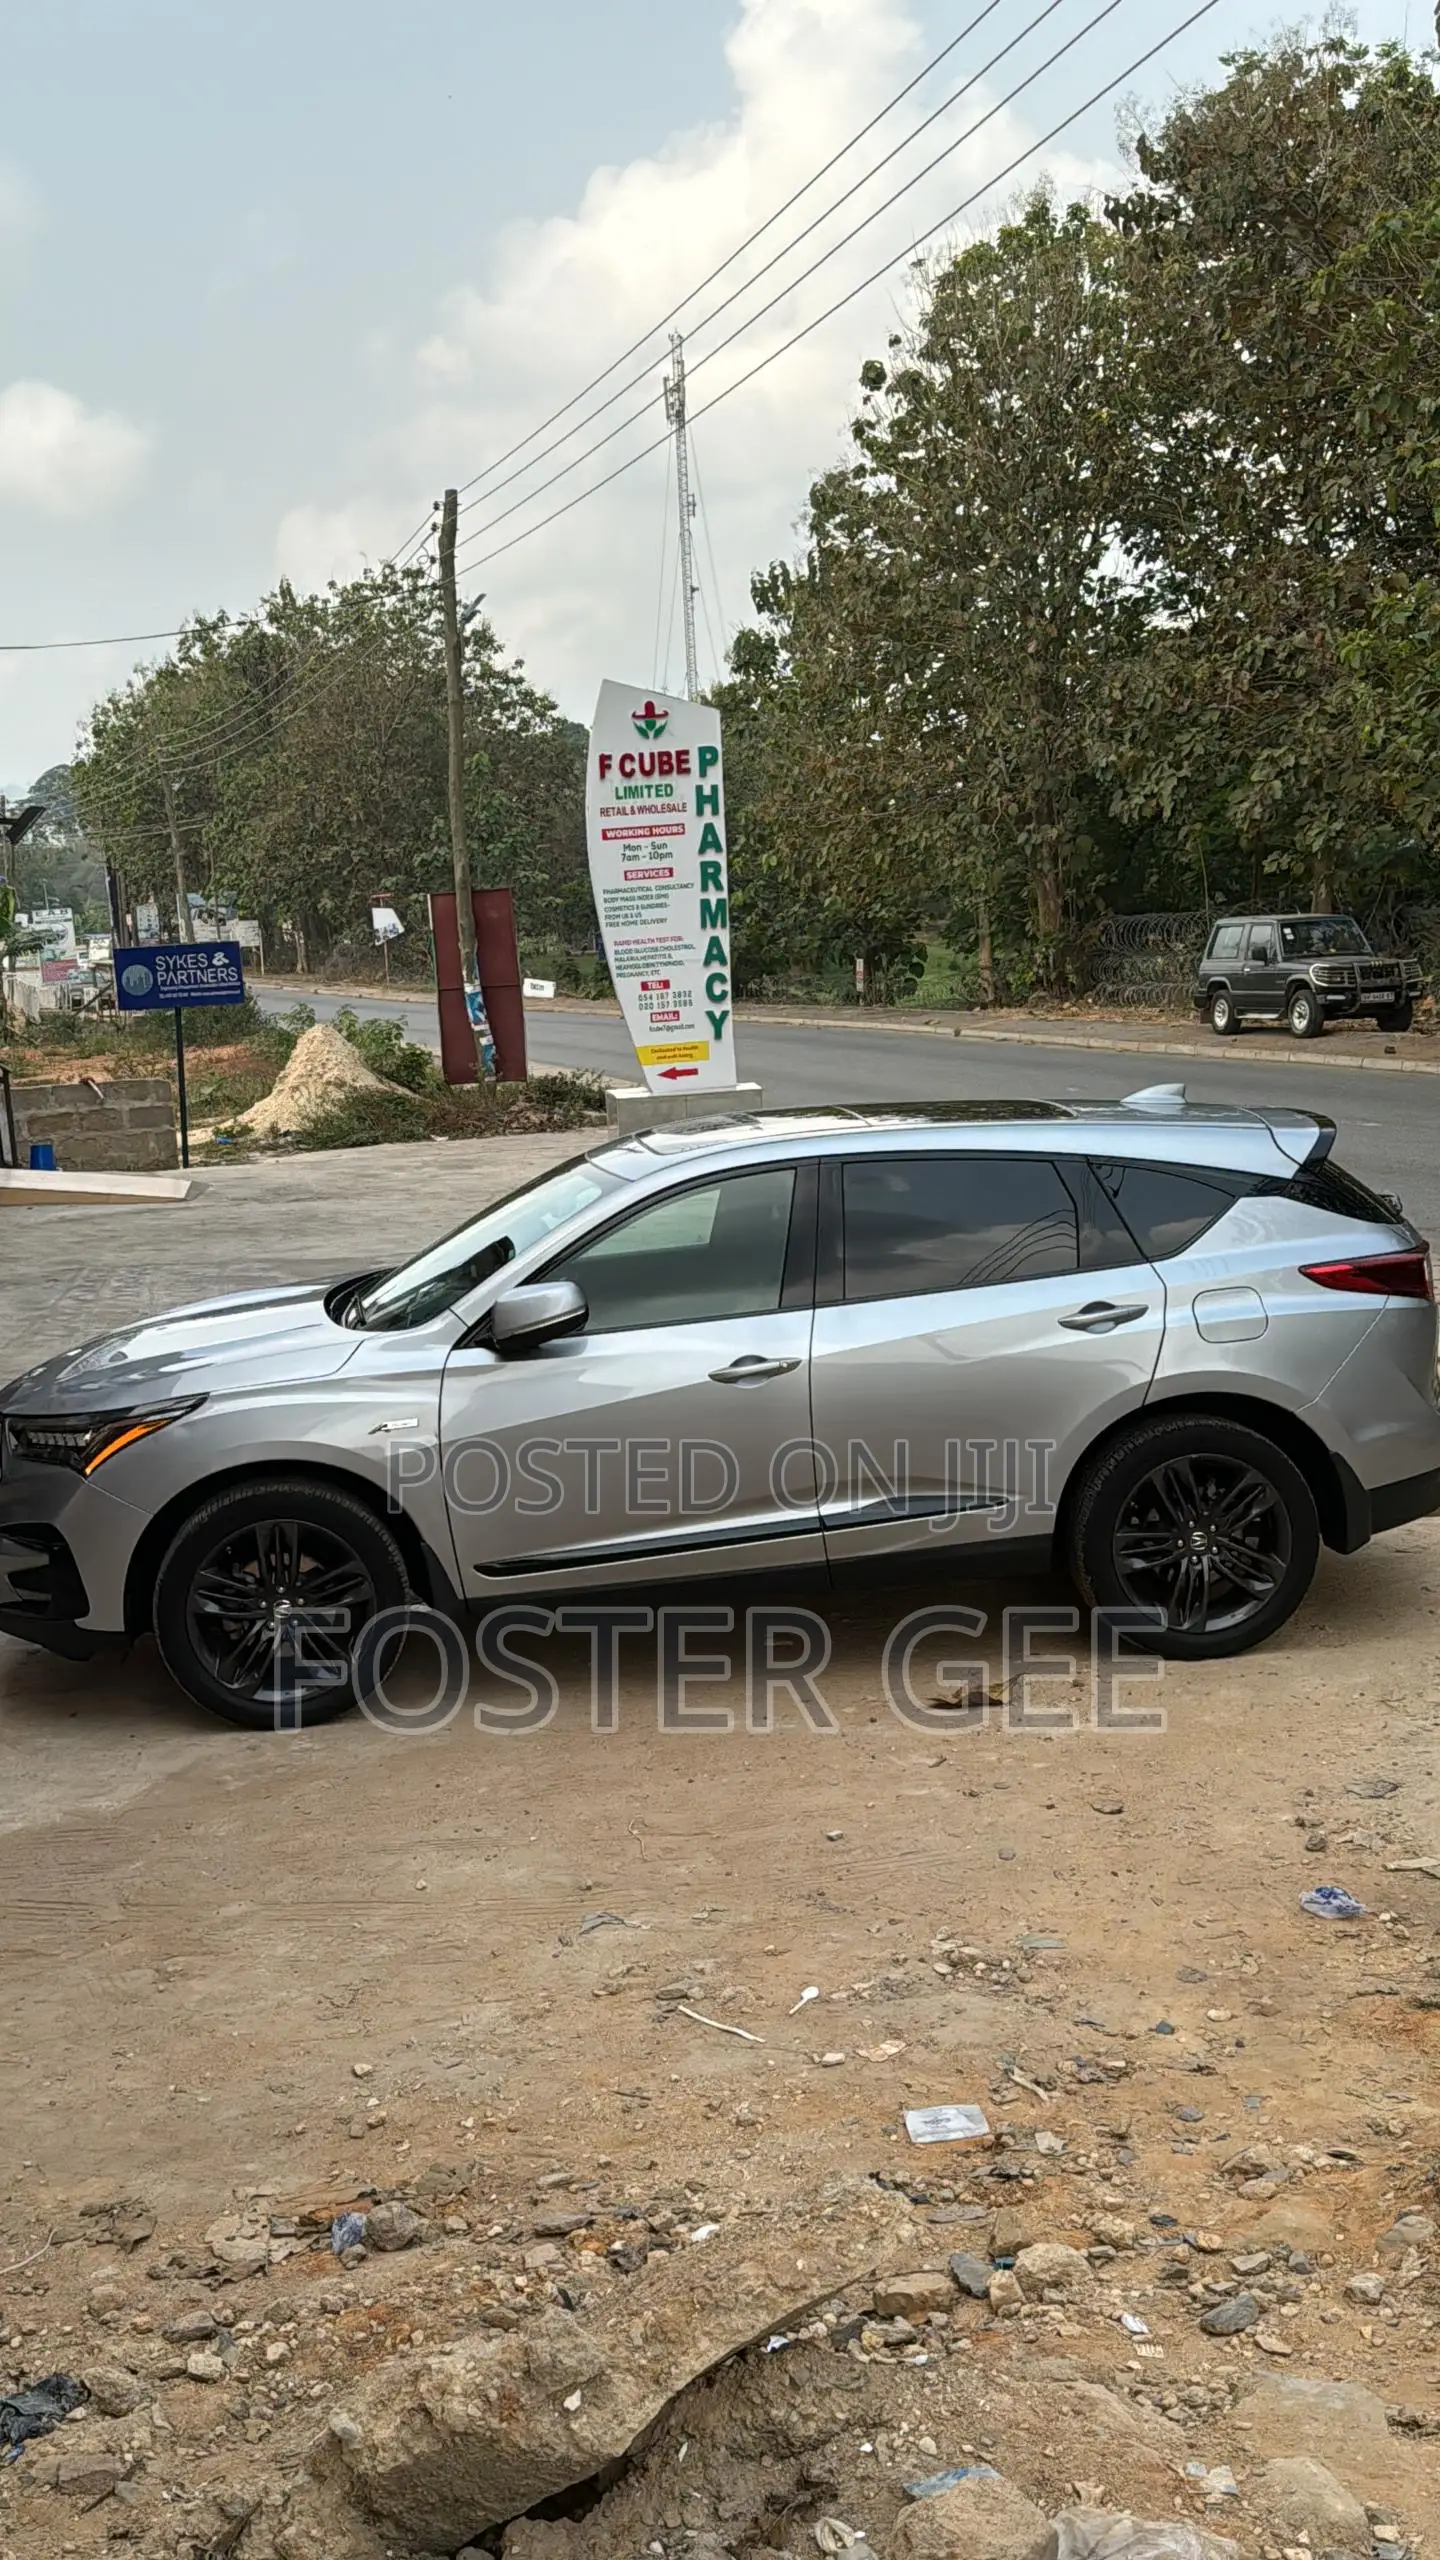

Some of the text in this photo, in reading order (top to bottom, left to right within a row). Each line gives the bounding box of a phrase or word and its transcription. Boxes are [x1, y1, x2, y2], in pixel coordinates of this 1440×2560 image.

[598, 749, 692, 780] F CUBE
[615, 783, 674, 800] LIMITED
[600, 802, 688, 817] RETAIL & WHOLESALE
[606, 824, 684, 839] WORKING HOURS
[623, 843, 642, 852] Mon
[651, 841, 668, 850] Sun
[621, 853, 640, 862] 7am
[649, 851, 673, 861] 10pm
[626, 868, 670, 880] SERVICES
[603, 882, 695, 895] PHARMACEUTICAL CONSULTANCY
[695, 745, 730, 1041] PHARMACY
[603, 904, 635, 913] COSMETICS
[604, 913, 621, 921] FROM
[621, 919, 638, 927] HOME
[639, 917, 668, 926] DELIVERY
[155, 951, 230, 971] SYKES &
[157, 967, 239, 986] PARTNERS
[652, 1012, 678, 1022] EMAIL:
